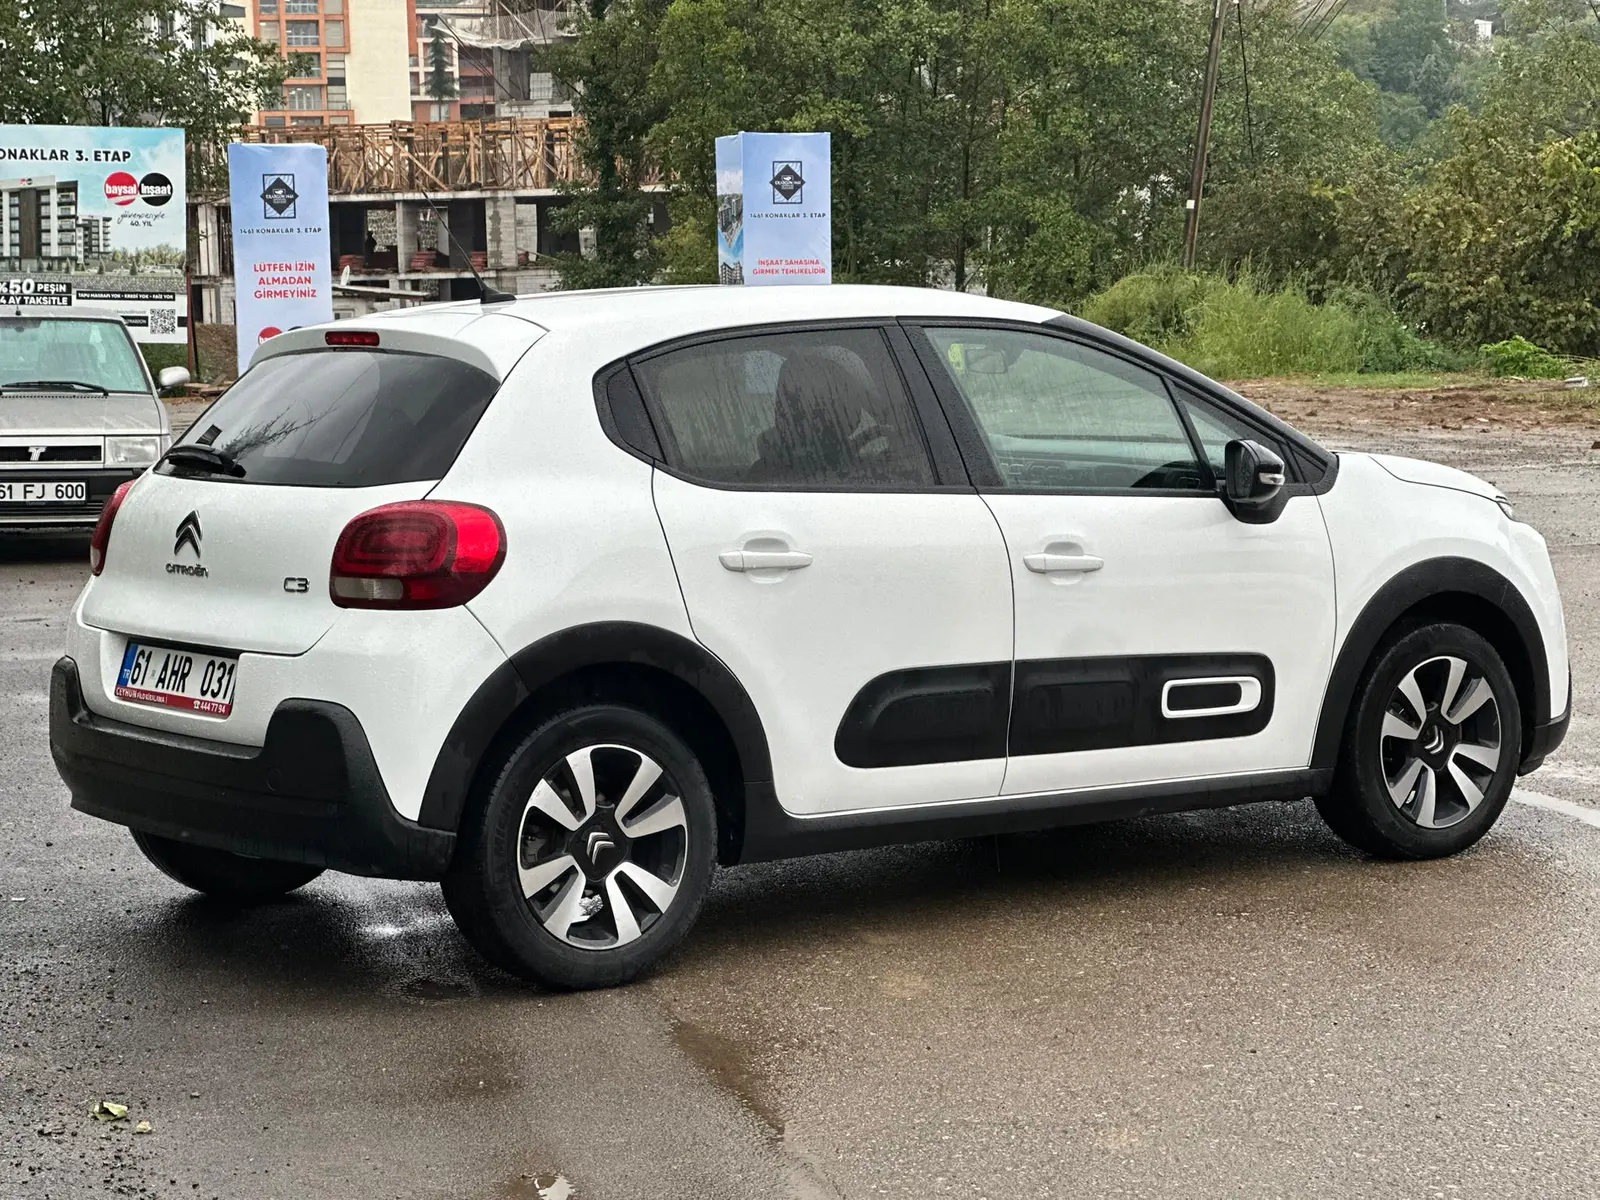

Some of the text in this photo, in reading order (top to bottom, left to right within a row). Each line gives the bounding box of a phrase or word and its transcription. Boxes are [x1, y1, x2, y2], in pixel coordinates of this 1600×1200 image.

[76, 150, 88, 162] 3.
[94, 150, 131, 162] ETAP
[105, 183, 137, 196] baysal
[254, 260, 315, 272] LÜTFEN İZİN
[258, 276, 312, 285] ALMADAN
[254, 287, 316, 299] GİRMEYİNİZ
[23, 484, 46, 499] FJ
[55, 484, 85, 499] 600
[284, 577, 310, 593] C3
[122, 649, 236, 700] TR 61 AHR 031
[116, 687, 137, 698] CEYHUN
[200, 702, 226, 714] 444 77 94
